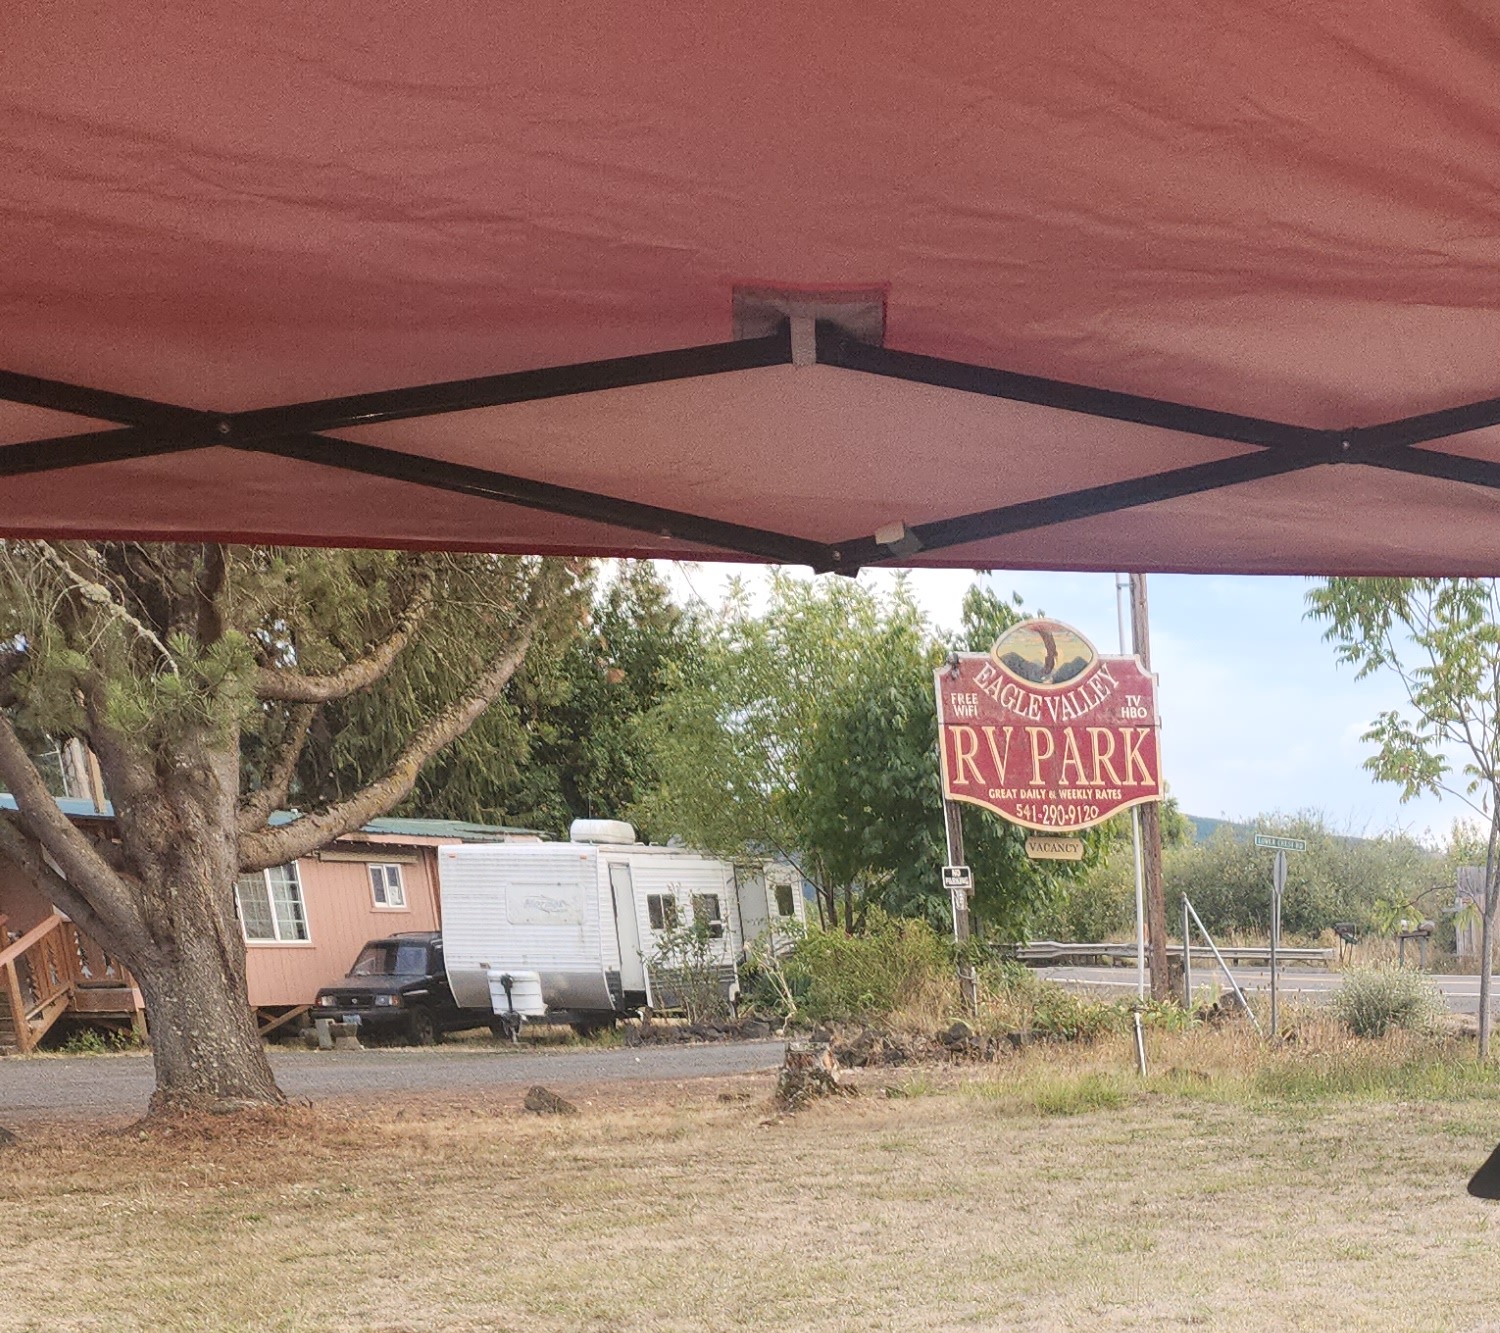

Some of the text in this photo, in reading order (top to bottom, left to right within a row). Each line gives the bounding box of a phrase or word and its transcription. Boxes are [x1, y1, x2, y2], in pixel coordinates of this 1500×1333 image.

[972, 662, 1119, 723] EAGLE VALLEY
[951, 693, 978, 705] FREE
[1125, 695, 1141, 707] TV
[1121, 706, 1148, 719] HBO
[949, 726, 1156, 786] RV PARK
[988, 788, 1122, 800] GREAT DAILY & WEEKLY RATES
[1028, 842, 1079, 854] VACANCY
